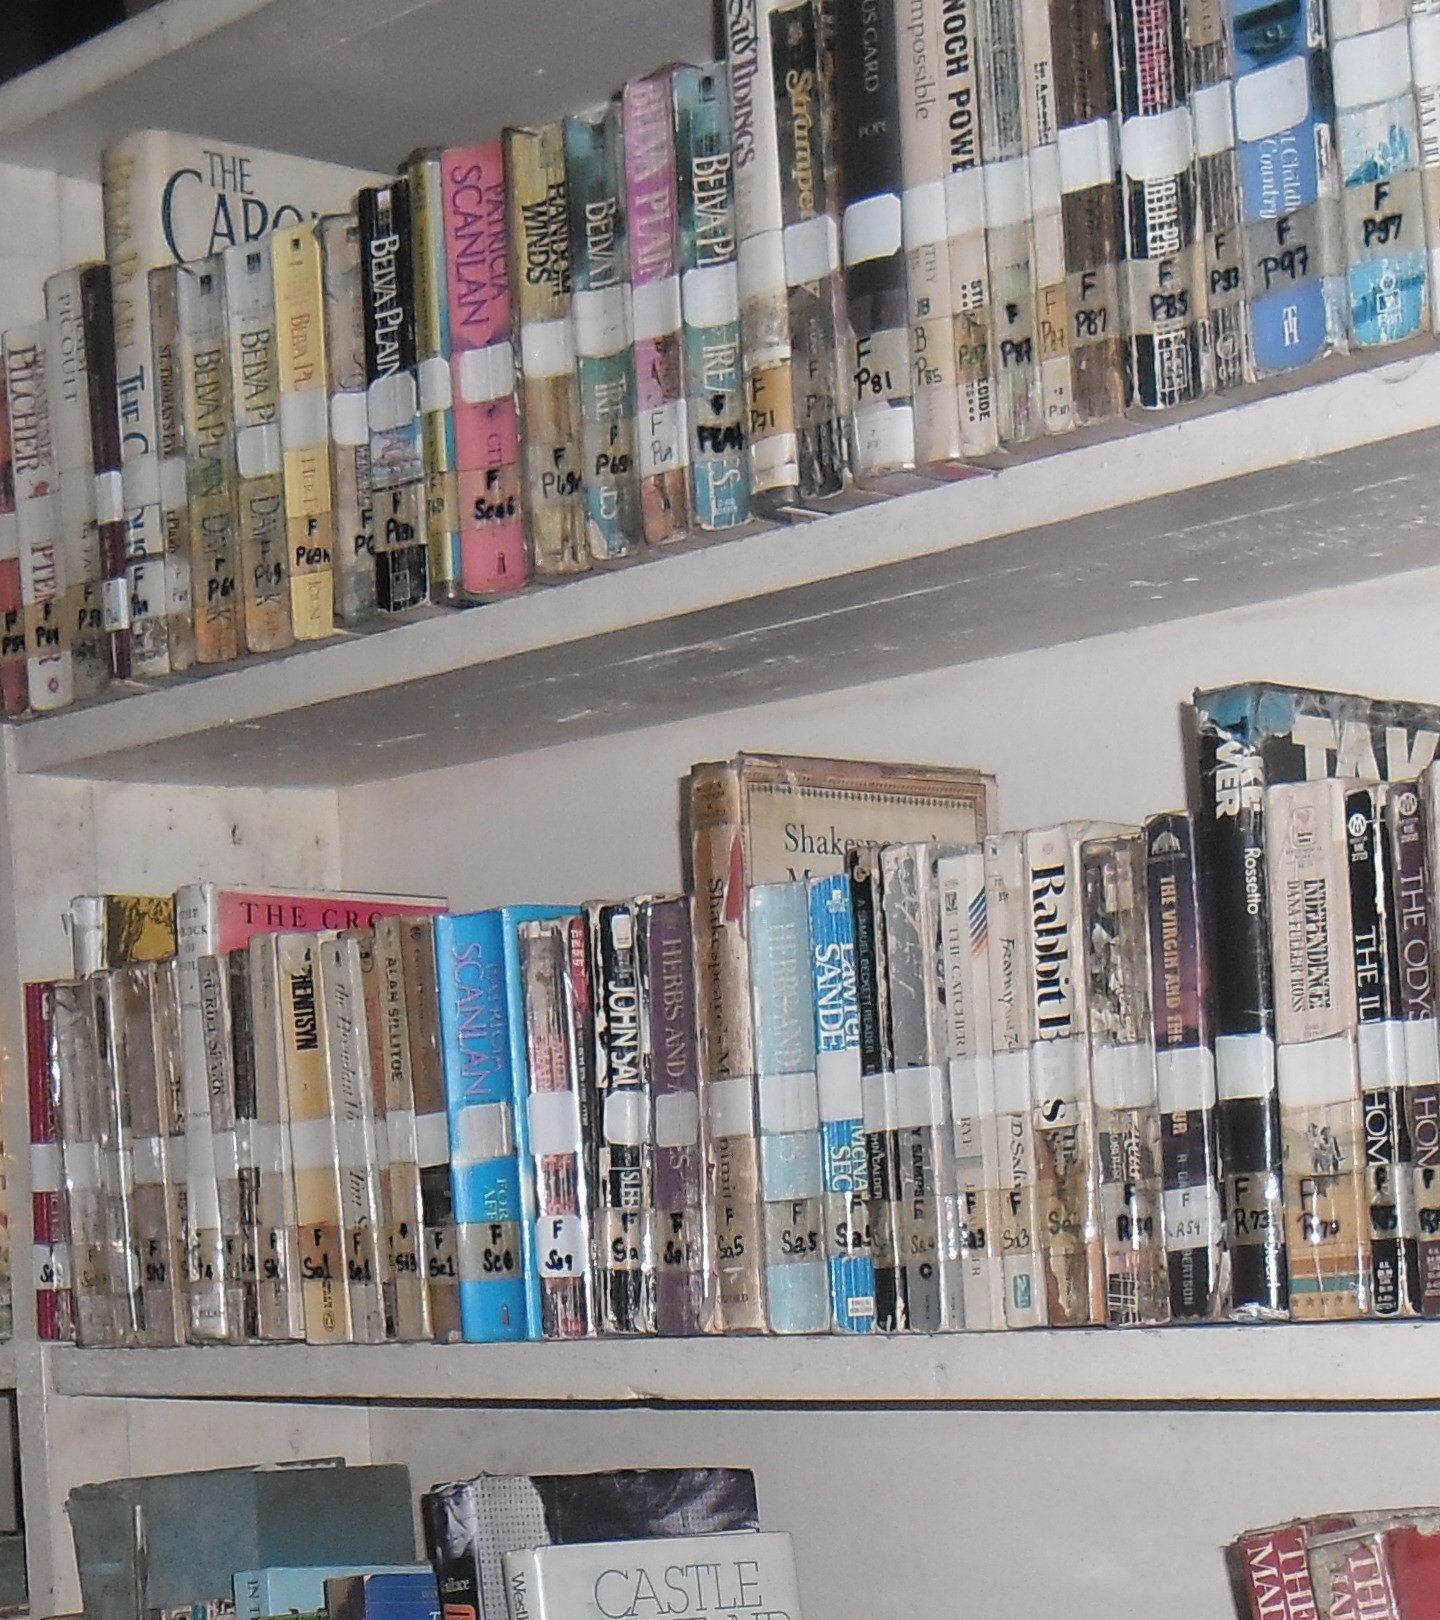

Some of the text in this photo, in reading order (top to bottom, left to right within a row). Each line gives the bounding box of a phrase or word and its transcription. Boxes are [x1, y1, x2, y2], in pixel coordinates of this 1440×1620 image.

[203, 150, 253, 194] THE
[449, 164, 491, 329] SCANLAN
[522, 202, 553, 285] WINDS
[1244, 846, 1262, 915] Rossetto
[1400, 867, 1426, 930] THE
[240, 902, 309, 930] THE
[1031, 863, 1068, 1007] Rabbit
[662, 937, 683, 1020] HERBS
[1355, 924, 1379, 988] THE
[453, 940, 492, 1096] SCANLAN
[593, 1561, 764, 1619] CASTLE
